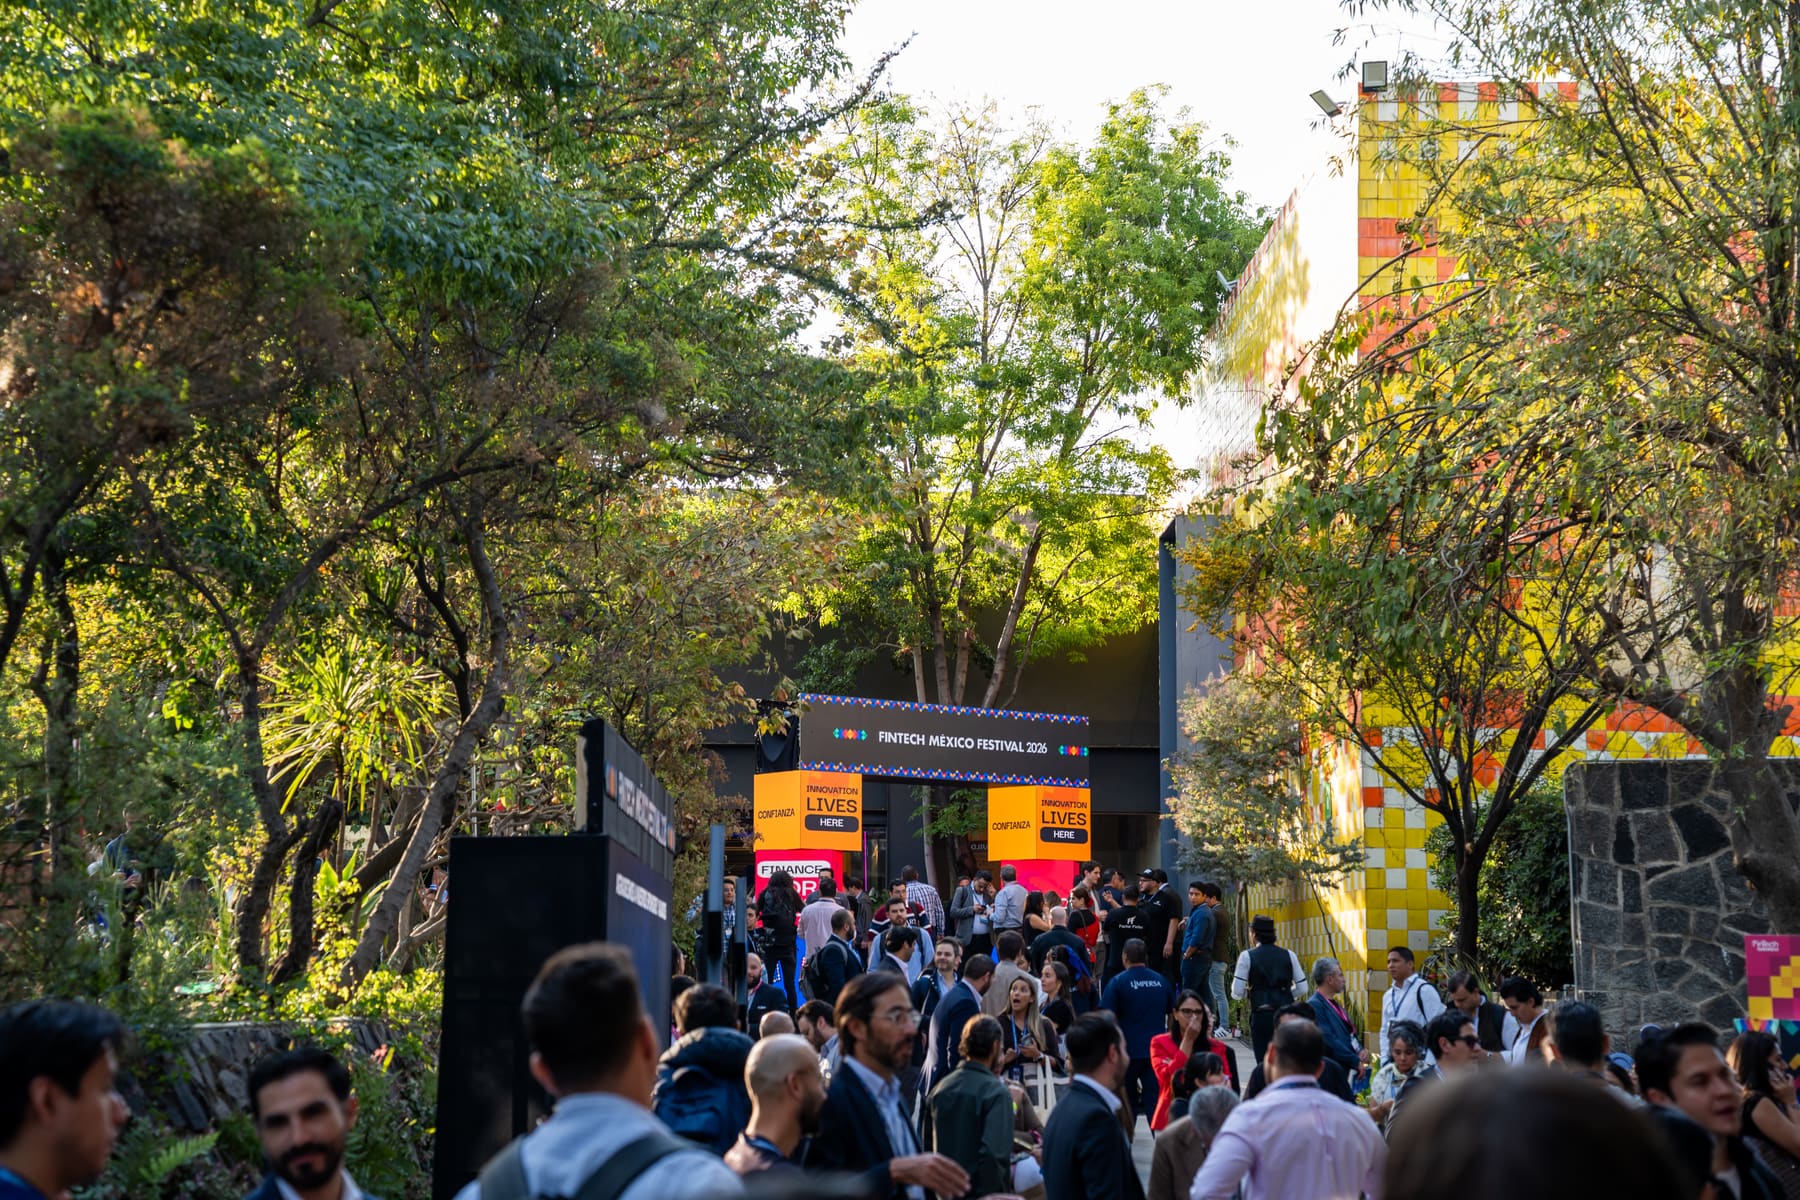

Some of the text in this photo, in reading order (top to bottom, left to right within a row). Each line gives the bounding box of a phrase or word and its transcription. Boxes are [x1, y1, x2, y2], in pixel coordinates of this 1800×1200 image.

[879, 731, 1048, 754] FINTECH MÉXICO FESTIVAL 2026
[806, 785, 858, 795] INNOVATION
[806, 797, 857, 813] LIVES
[1041, 800, 1087, 808] INNOVATION
[758, 808, 795, 819] CONFIANZA
[1041, 810, 1087, 826] LIVES
[819, 818, 844, 827] HERE
[992, 821, 1031, 830] CONFIANZA
[1053, 830, 1075, 839] HERE
[761, 865, 822, 875] FINANCE
